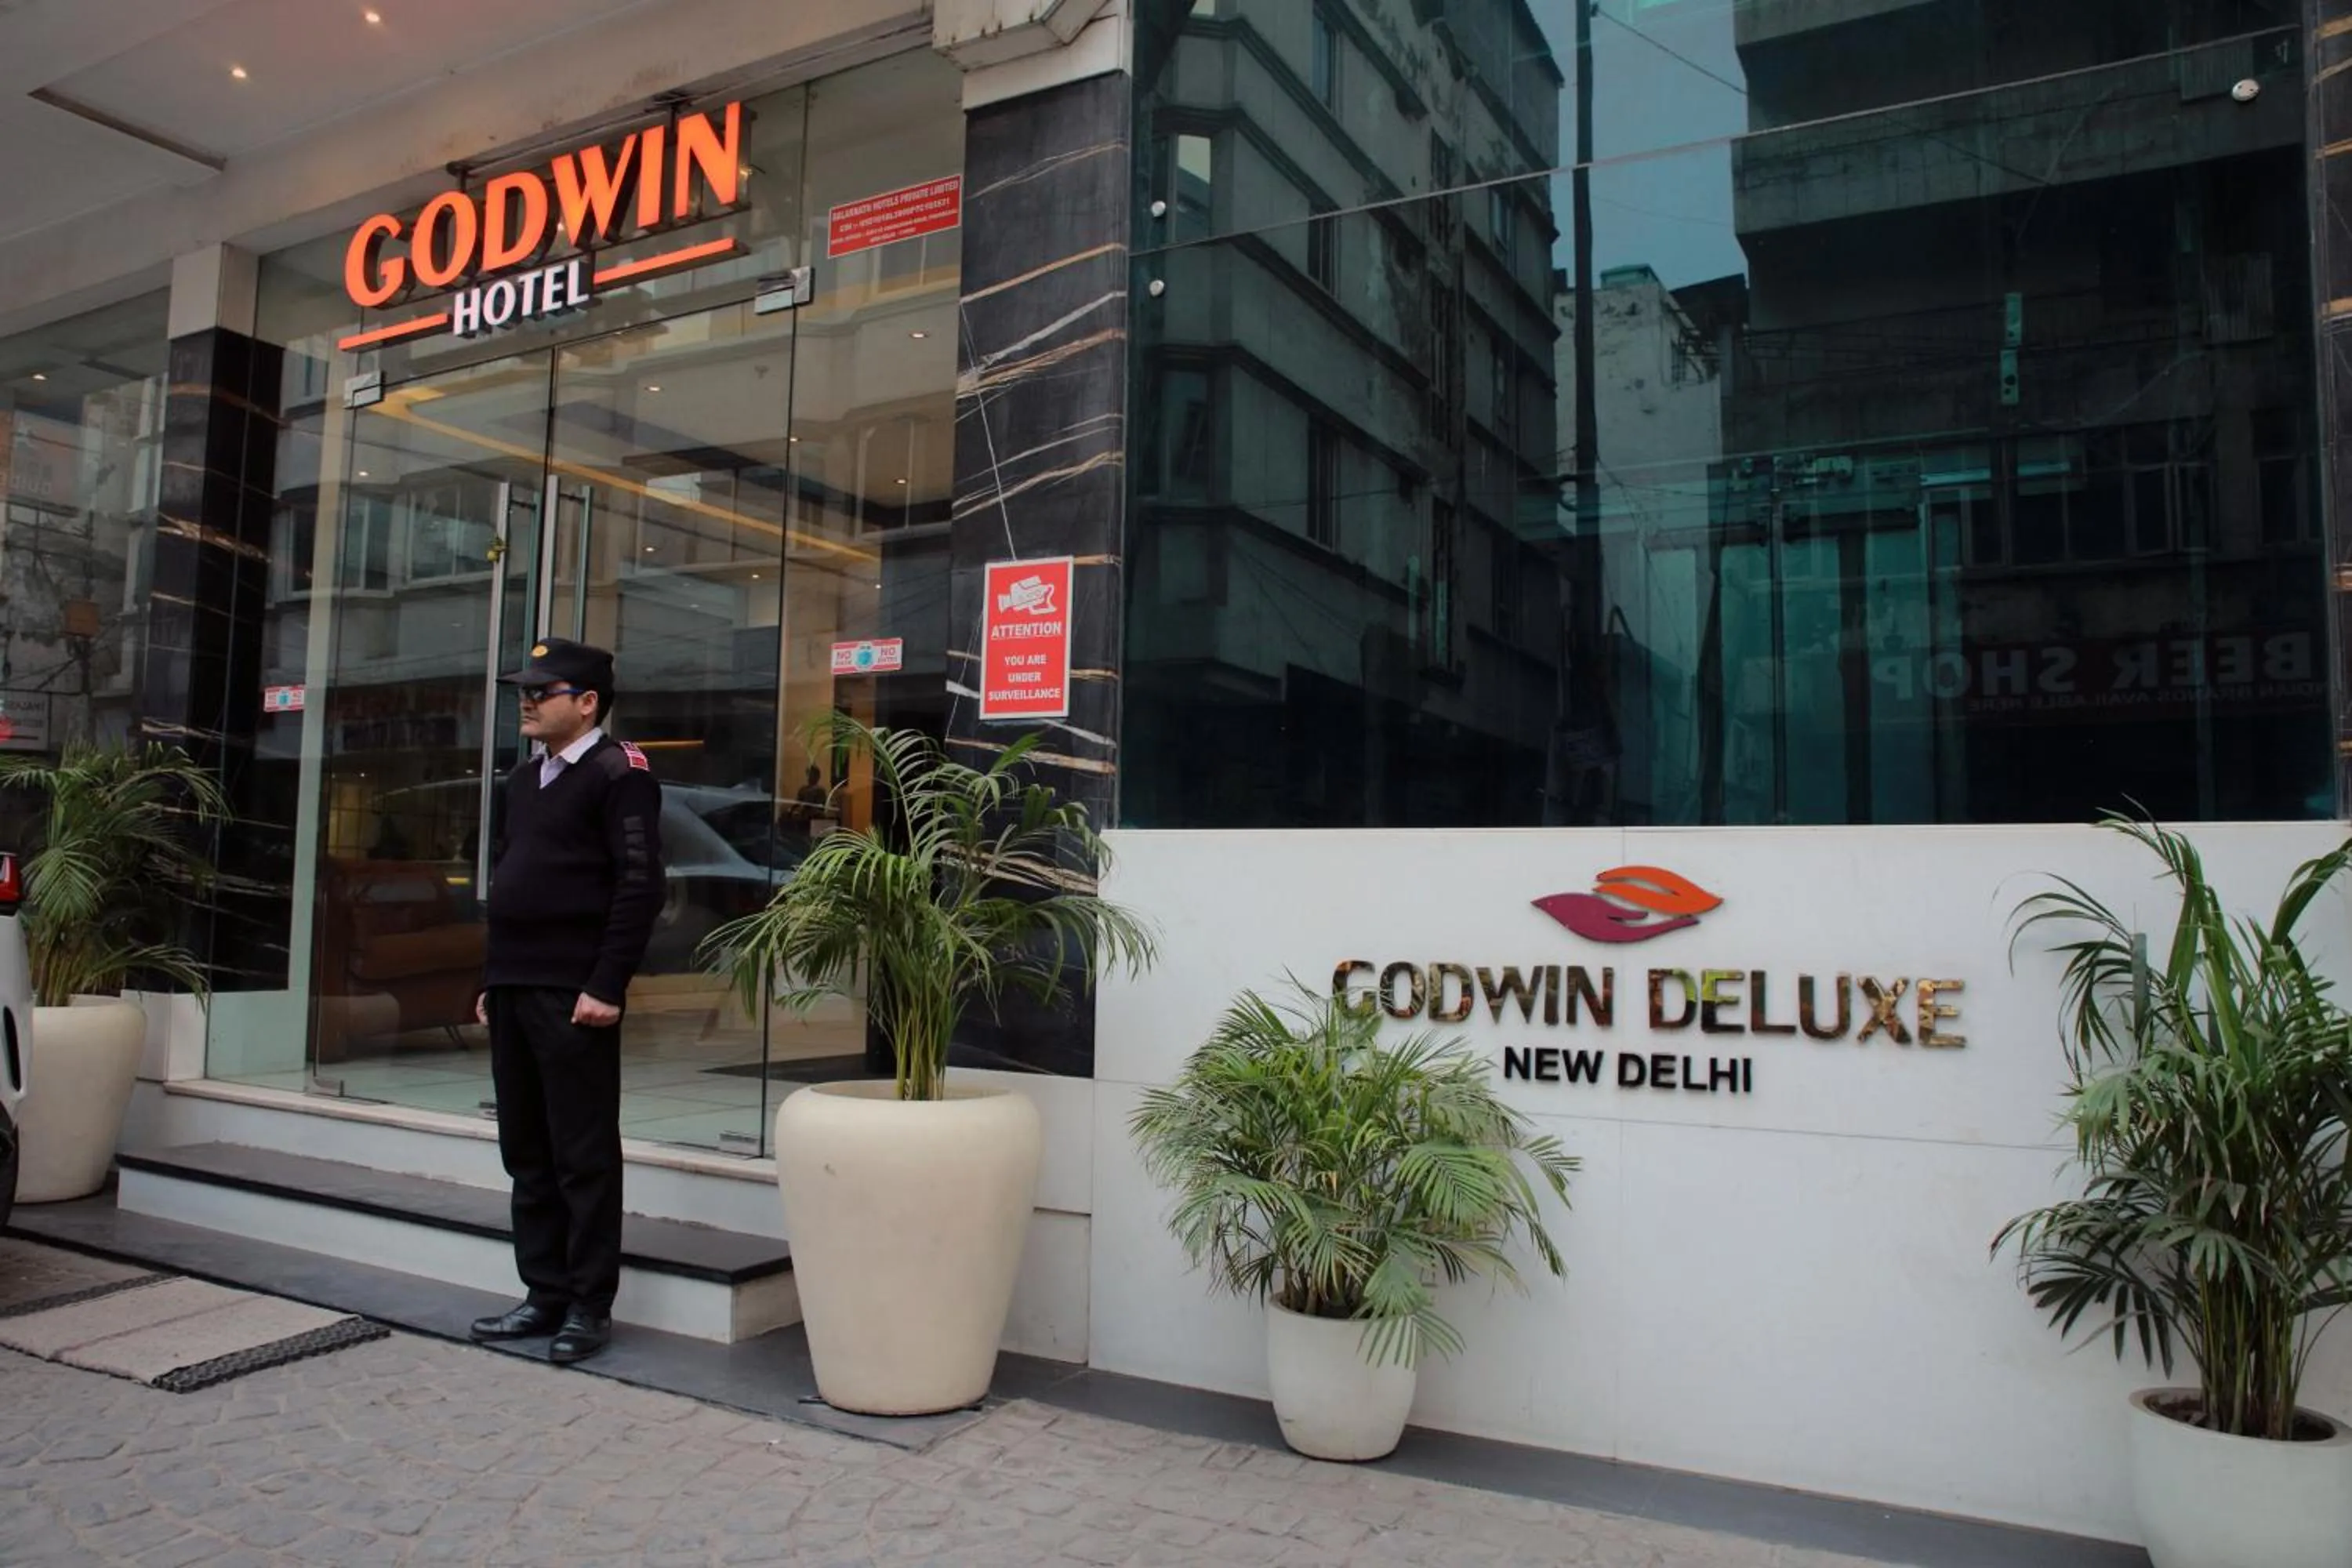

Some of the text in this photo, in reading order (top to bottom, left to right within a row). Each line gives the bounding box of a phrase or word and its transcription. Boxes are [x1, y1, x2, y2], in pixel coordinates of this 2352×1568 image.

[930, 180, 958, 195] LIMITED
[344, 100, 742, 307] GODWIN
[453, 260, 590, 336] HOTEL
[990, 621, 1062, 639] ATTENTION
[880, 646, 896, 656] NO
[1004, 653, 1047, 666] YOU ARE
[1008, 671, 1042, 684] UNDER
[988, 688, 1061, 702] SURVEILLANCE
[1331, 960, 1968, 1049] GODWIN DELUXE
[1504, 1046, 1752, 1093] NEW DELHI
